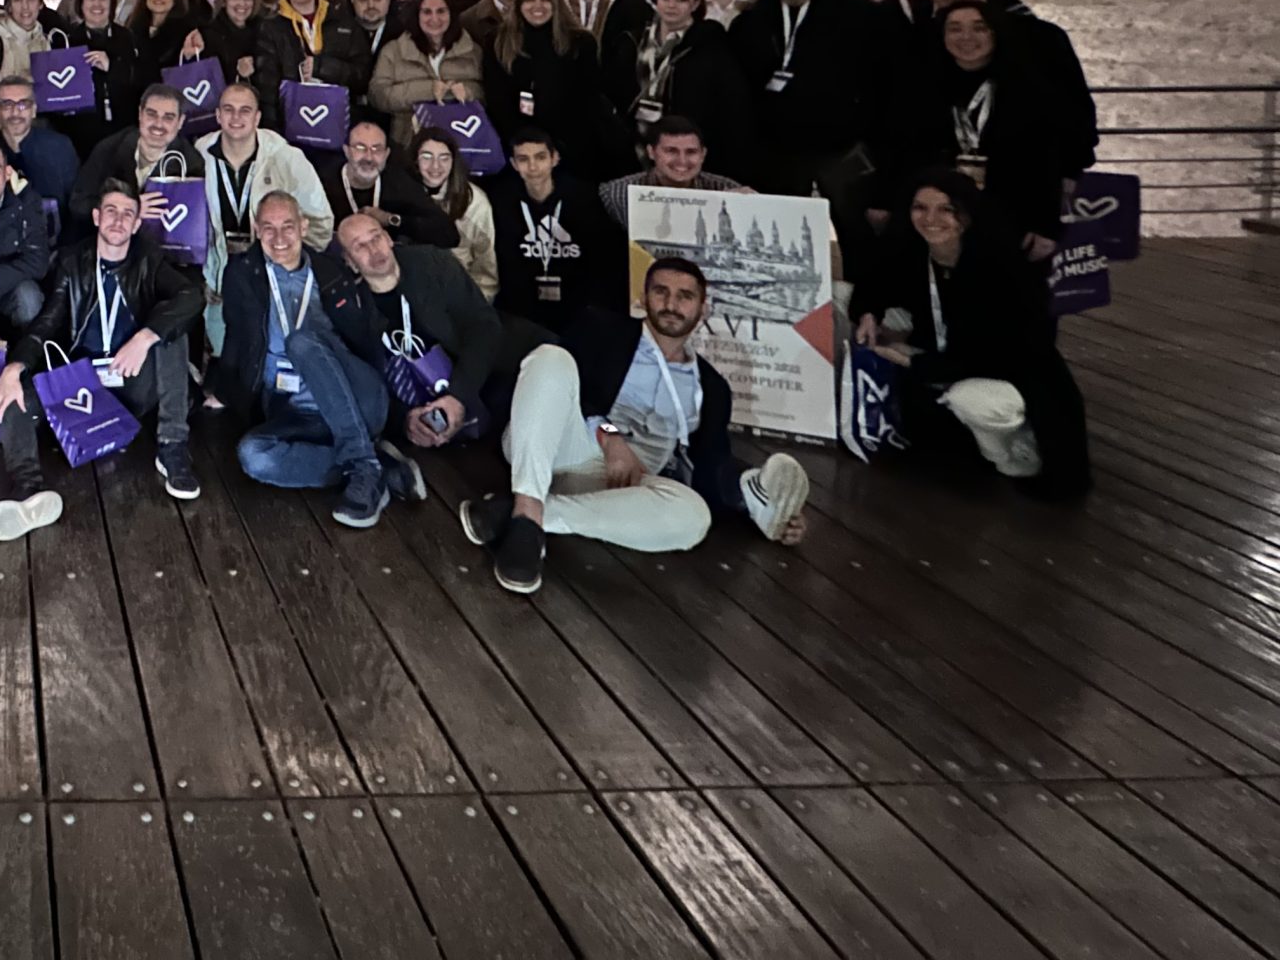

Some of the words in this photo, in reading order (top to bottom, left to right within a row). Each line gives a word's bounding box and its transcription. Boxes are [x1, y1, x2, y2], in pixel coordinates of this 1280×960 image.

[653, 193, 708, 207] ecomputer
[1065, 244, 1096, 261] LIFE
[1064, 256, 1108, 277] MUSIC
[725, 371, 804, 393] COMPUTER
